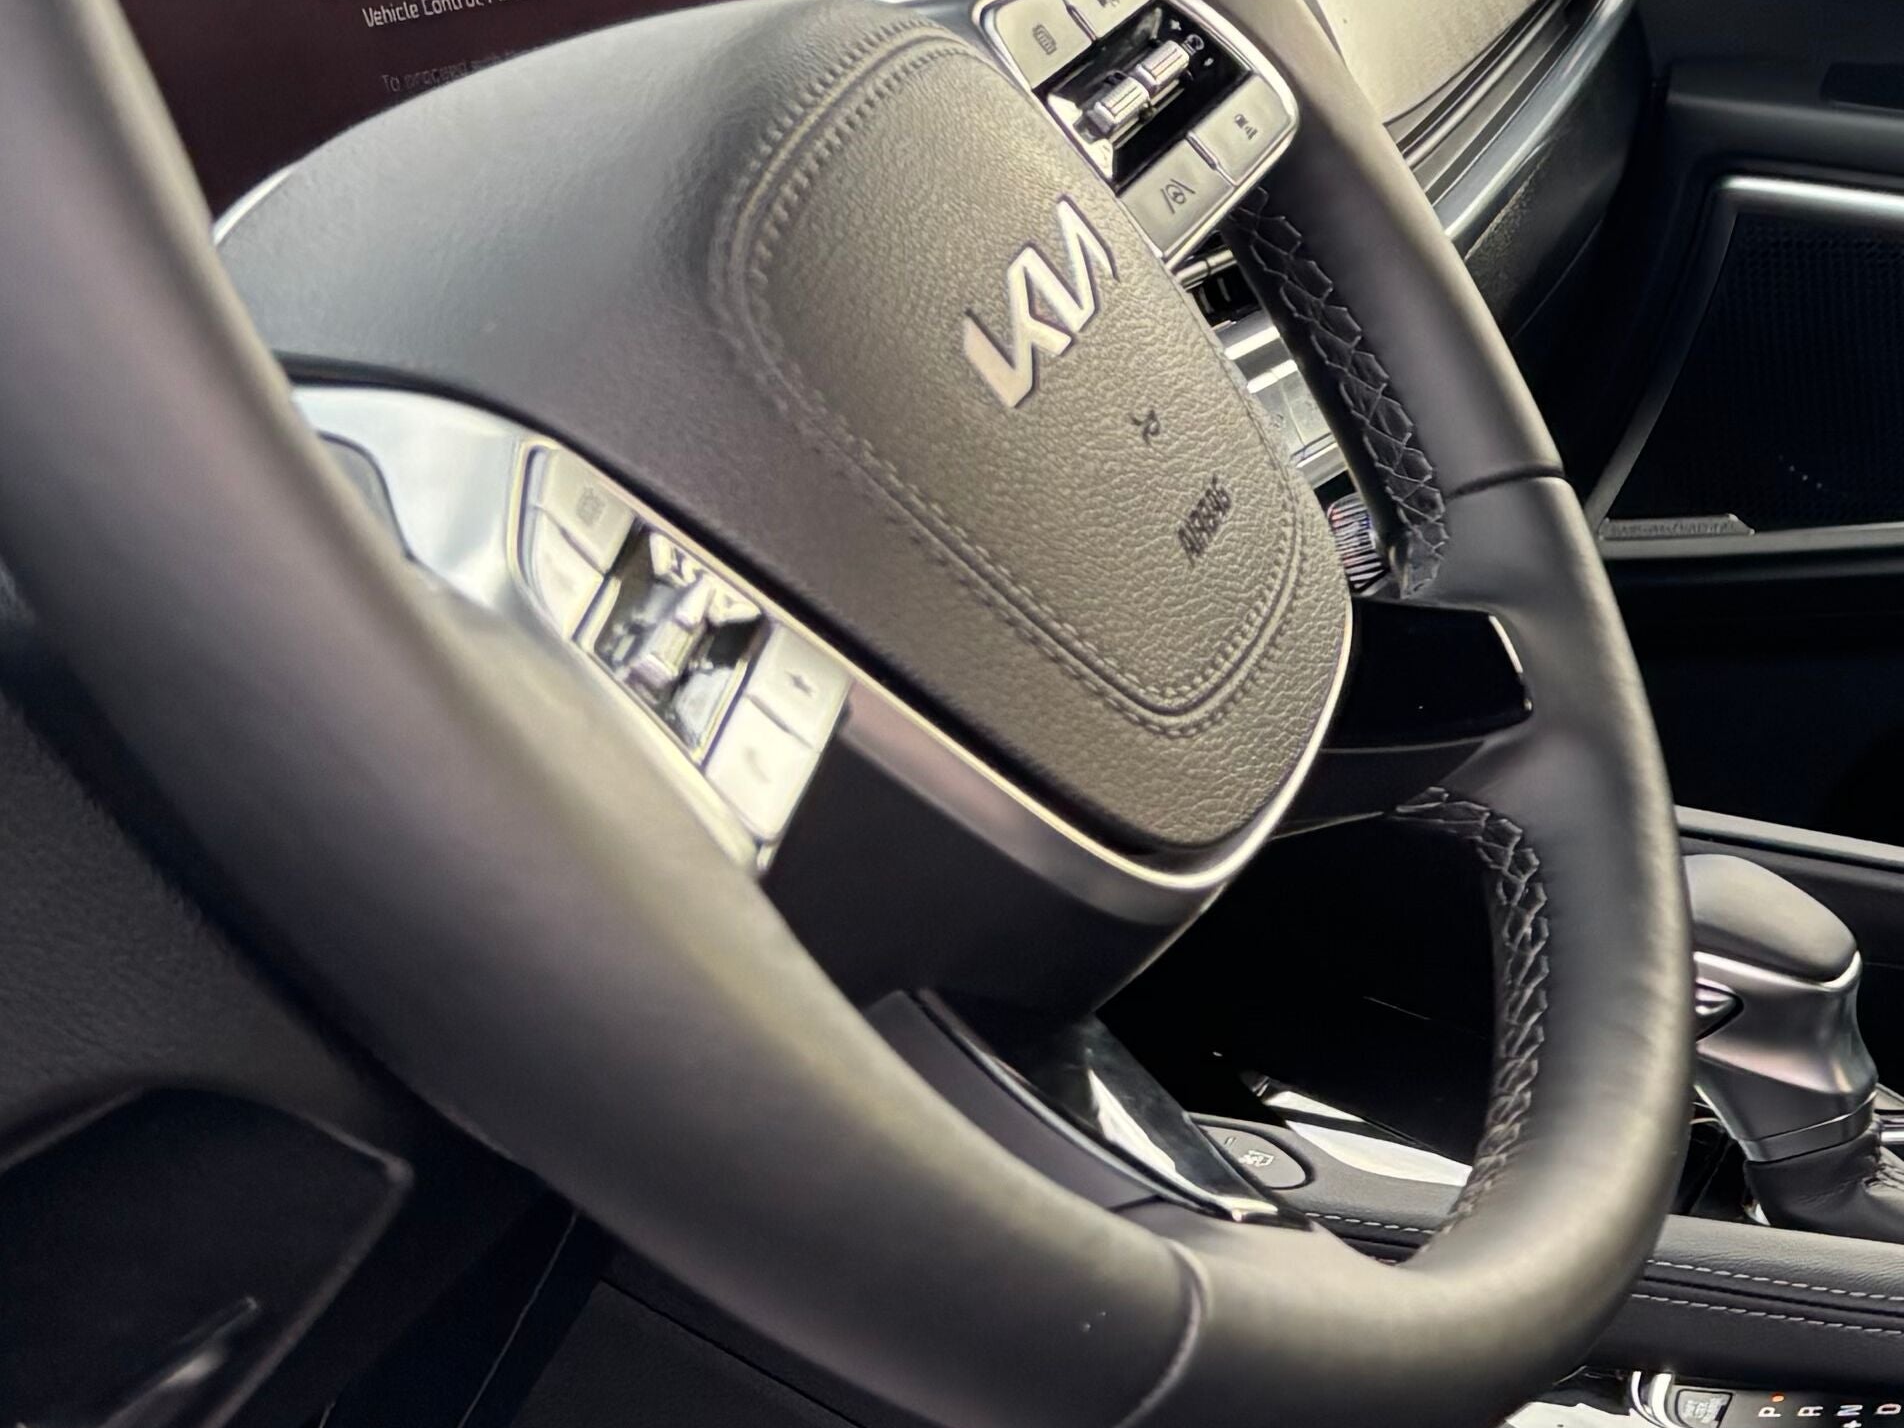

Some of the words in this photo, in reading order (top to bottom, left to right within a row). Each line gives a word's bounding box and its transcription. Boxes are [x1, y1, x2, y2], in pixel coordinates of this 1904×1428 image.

[362, 2, 419, 28] Vehicle
[1758, 1406, 1782, 1418] P
[1874, 1403, 1902, 1415] D
